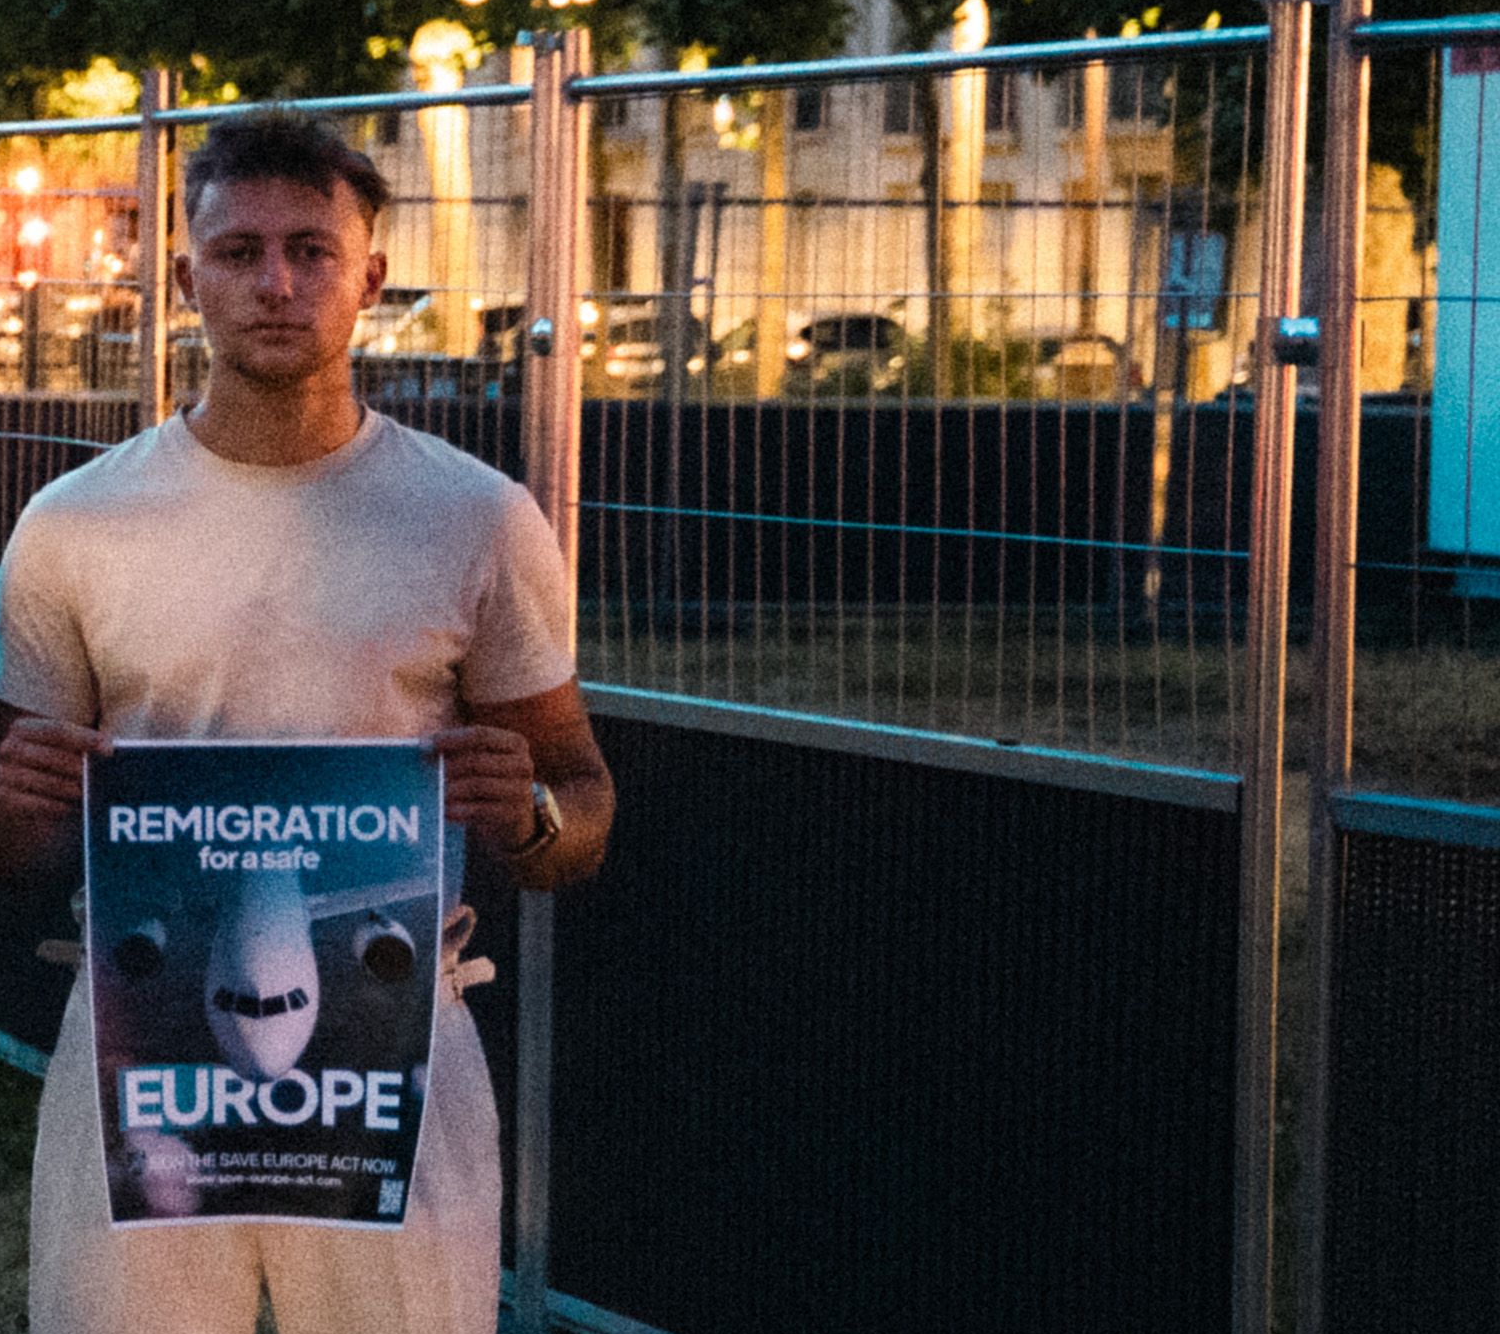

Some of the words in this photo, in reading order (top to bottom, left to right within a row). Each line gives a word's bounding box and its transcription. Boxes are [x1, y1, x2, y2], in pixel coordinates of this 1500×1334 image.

[109, 805, 419, 843] REMIGRATION
[199, 845, 239, 869] for
[241, 851, 257, 869] a
[261, 845, 320, 870] safe
[126, 1068, 403, 1130] EUROPE
[189, 1153, 216, 1168] THE
[219, 1153, 260, 1168] SAVE
[263, 1154, 327, 1169] EUROPE
[330, 1156, 361, 1171] ACT
[362, 1159, 397, 1175] NOW
